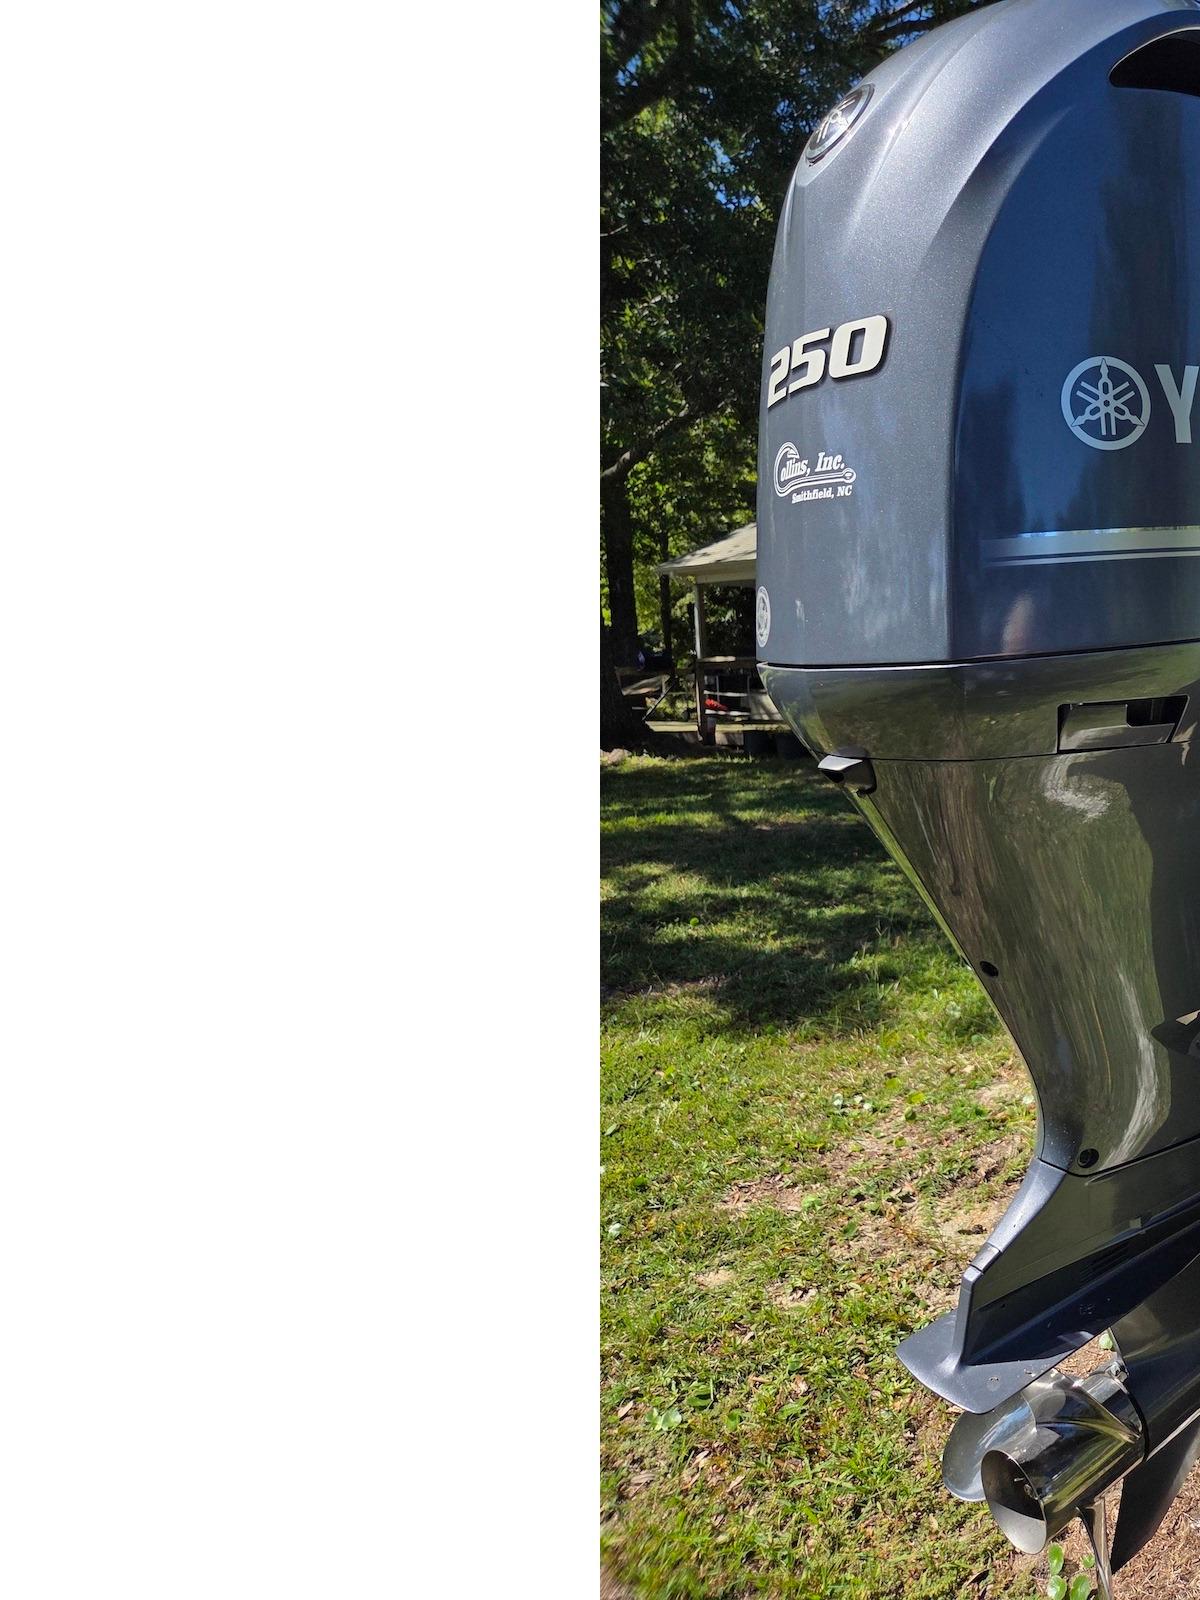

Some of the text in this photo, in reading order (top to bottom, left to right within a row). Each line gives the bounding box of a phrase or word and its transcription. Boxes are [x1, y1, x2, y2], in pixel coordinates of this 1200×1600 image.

[767, 315, 887, 408] 250
[815, 452, 845, 472] Inc.
[791, 485, 853, 504] Smithfield, NC
